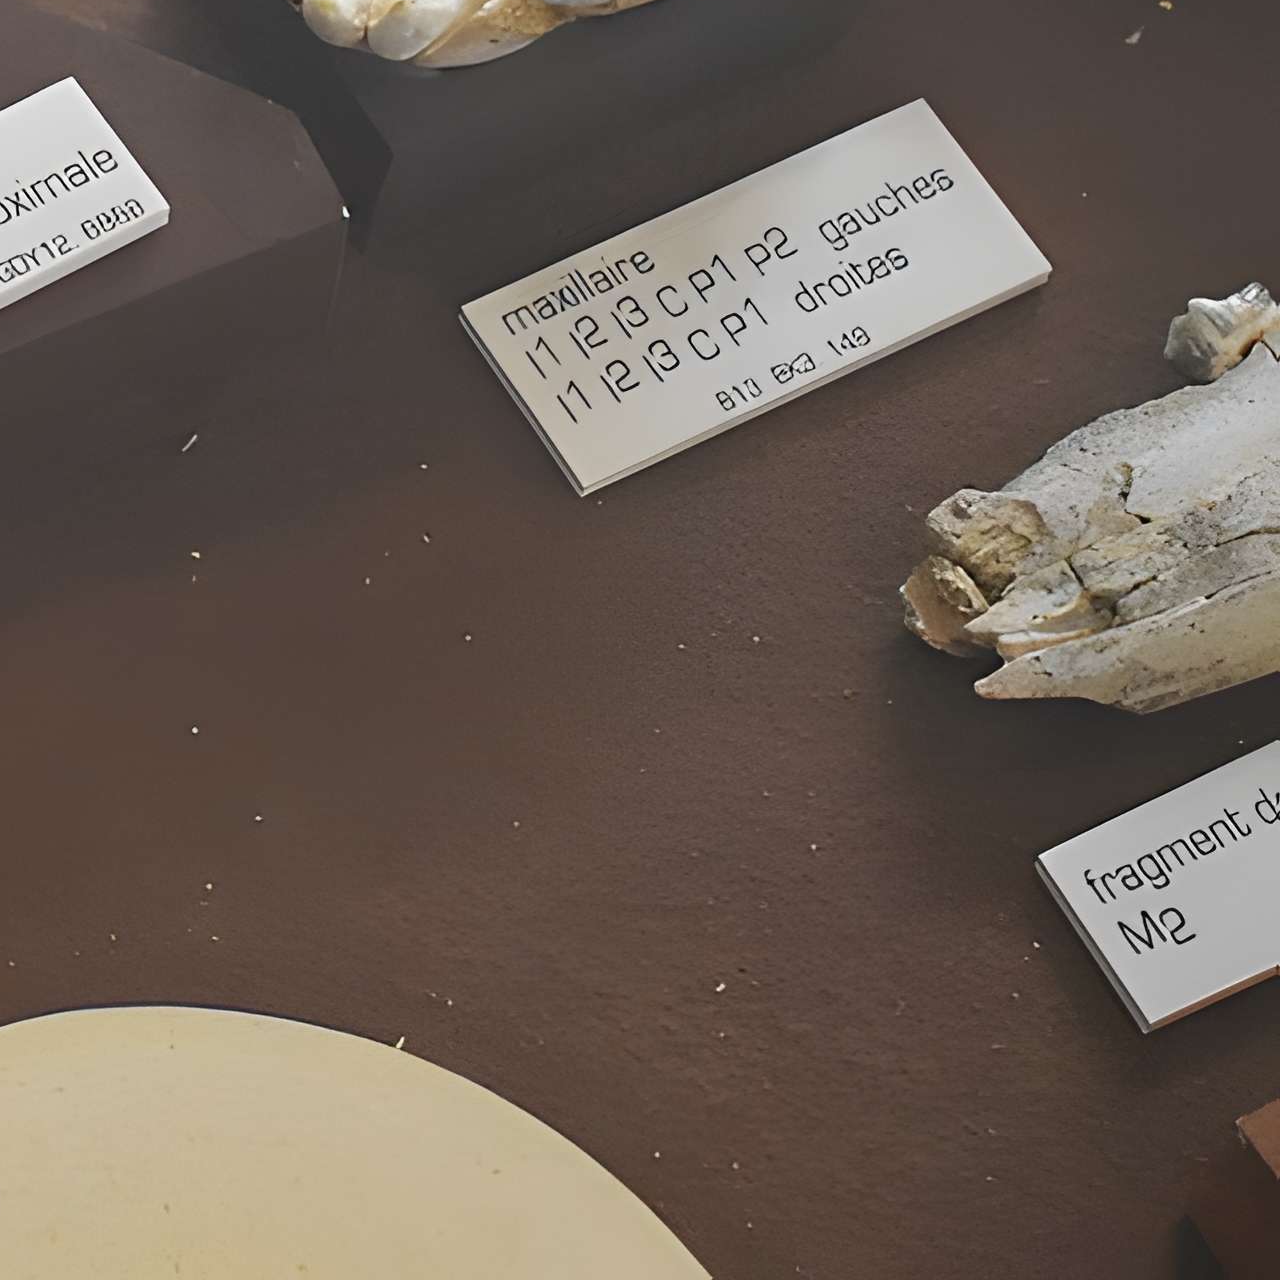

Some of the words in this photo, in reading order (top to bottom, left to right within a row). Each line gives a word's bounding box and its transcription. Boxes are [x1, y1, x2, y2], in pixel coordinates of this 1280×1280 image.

[817, 167, 955, 253] gauches
[501, 249, 656, 336] maxillaire
[793, 246, 910, 313] droites
[1083, 808, 1253, 905] fragment
[1116, 906, 1197, 955] M2
